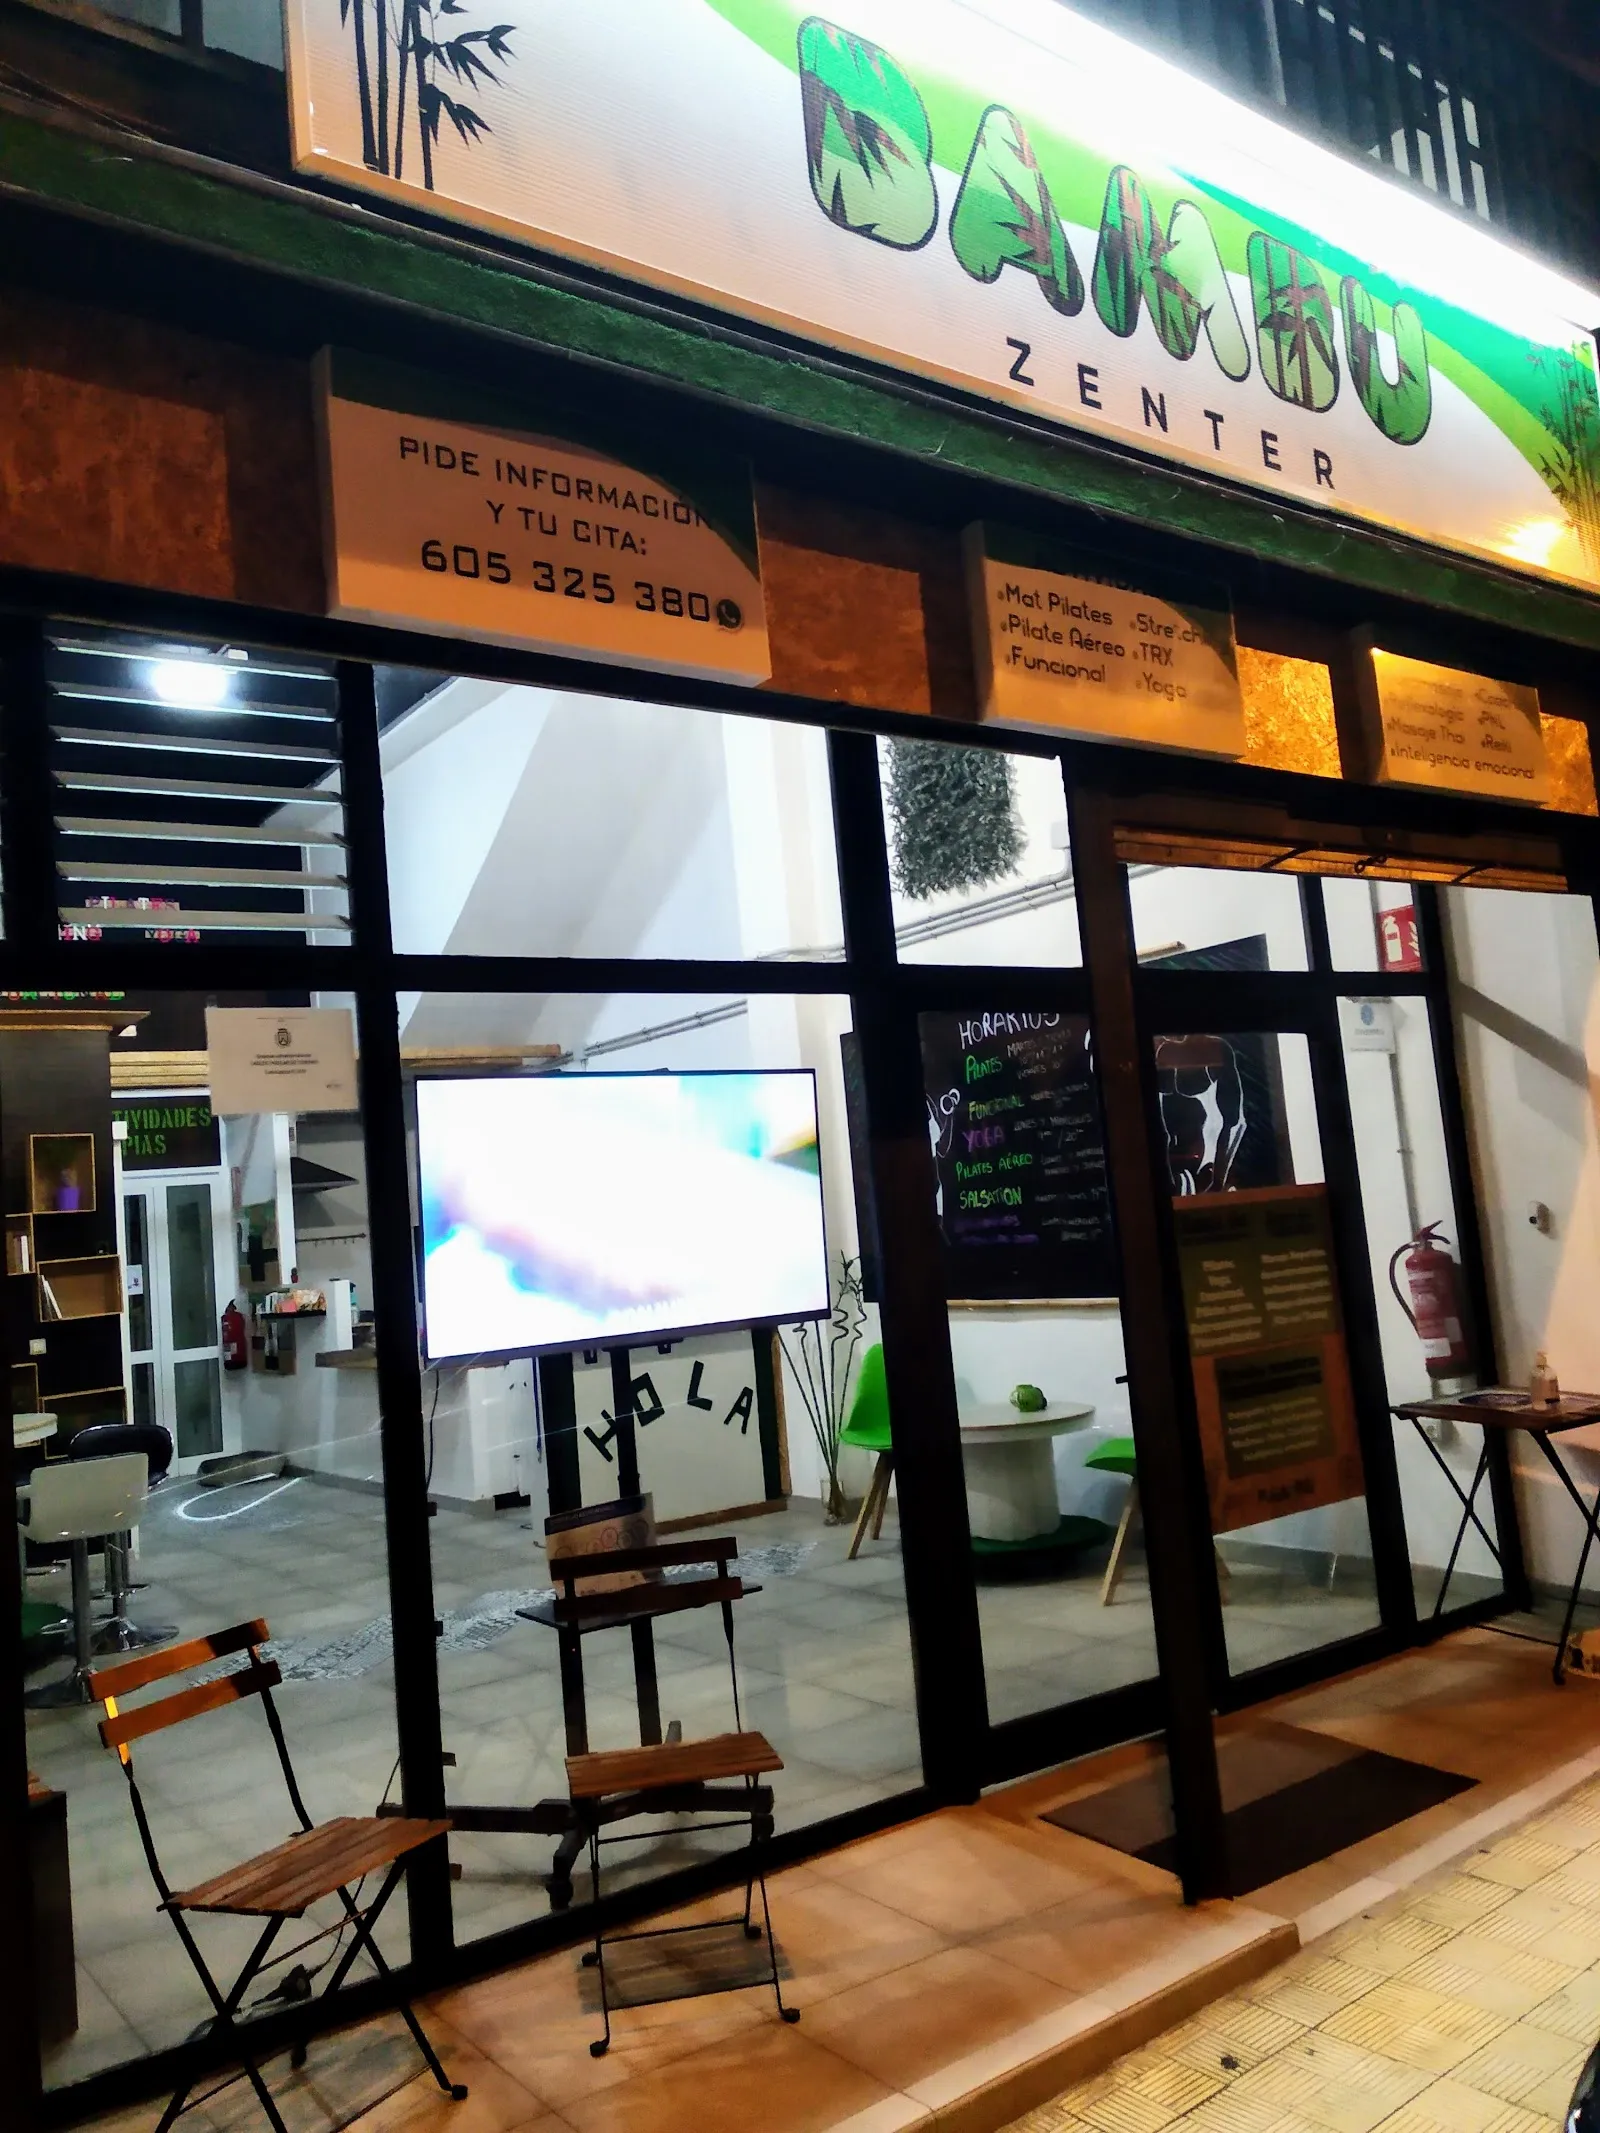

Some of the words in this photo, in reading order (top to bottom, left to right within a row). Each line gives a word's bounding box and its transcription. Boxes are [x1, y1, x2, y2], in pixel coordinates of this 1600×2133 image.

[796, 15, 1432, 446] BAMBU
[1007, 336, 1336, 491] ZENTER
[400, 436, 480, 478] PIDE
[486, 500, 505, 525] Y
[517, 507, 557, 536] TU
[573, 519, 648, 556] CITA:
[421, 539, 512, 585] 605
[532, 560, 616, 605] 325
[634, 581, 711, 623] 380
[1005, 582, 1042, 611] Mat
[1048, 592, 1114, 626] Pilates
[1008, 613, 1064, 646] Pilate
[1069, 626, 1126, 658] Aéreo
[1139, 642, 1174, 668] TRX
[1011, 645, 1107, 684] Funcional
[1142, 672, 1188, 702] Yoga
[1474, 759, 1536, 780] emocional
[584, 1360, 754, 1462] HOLA
